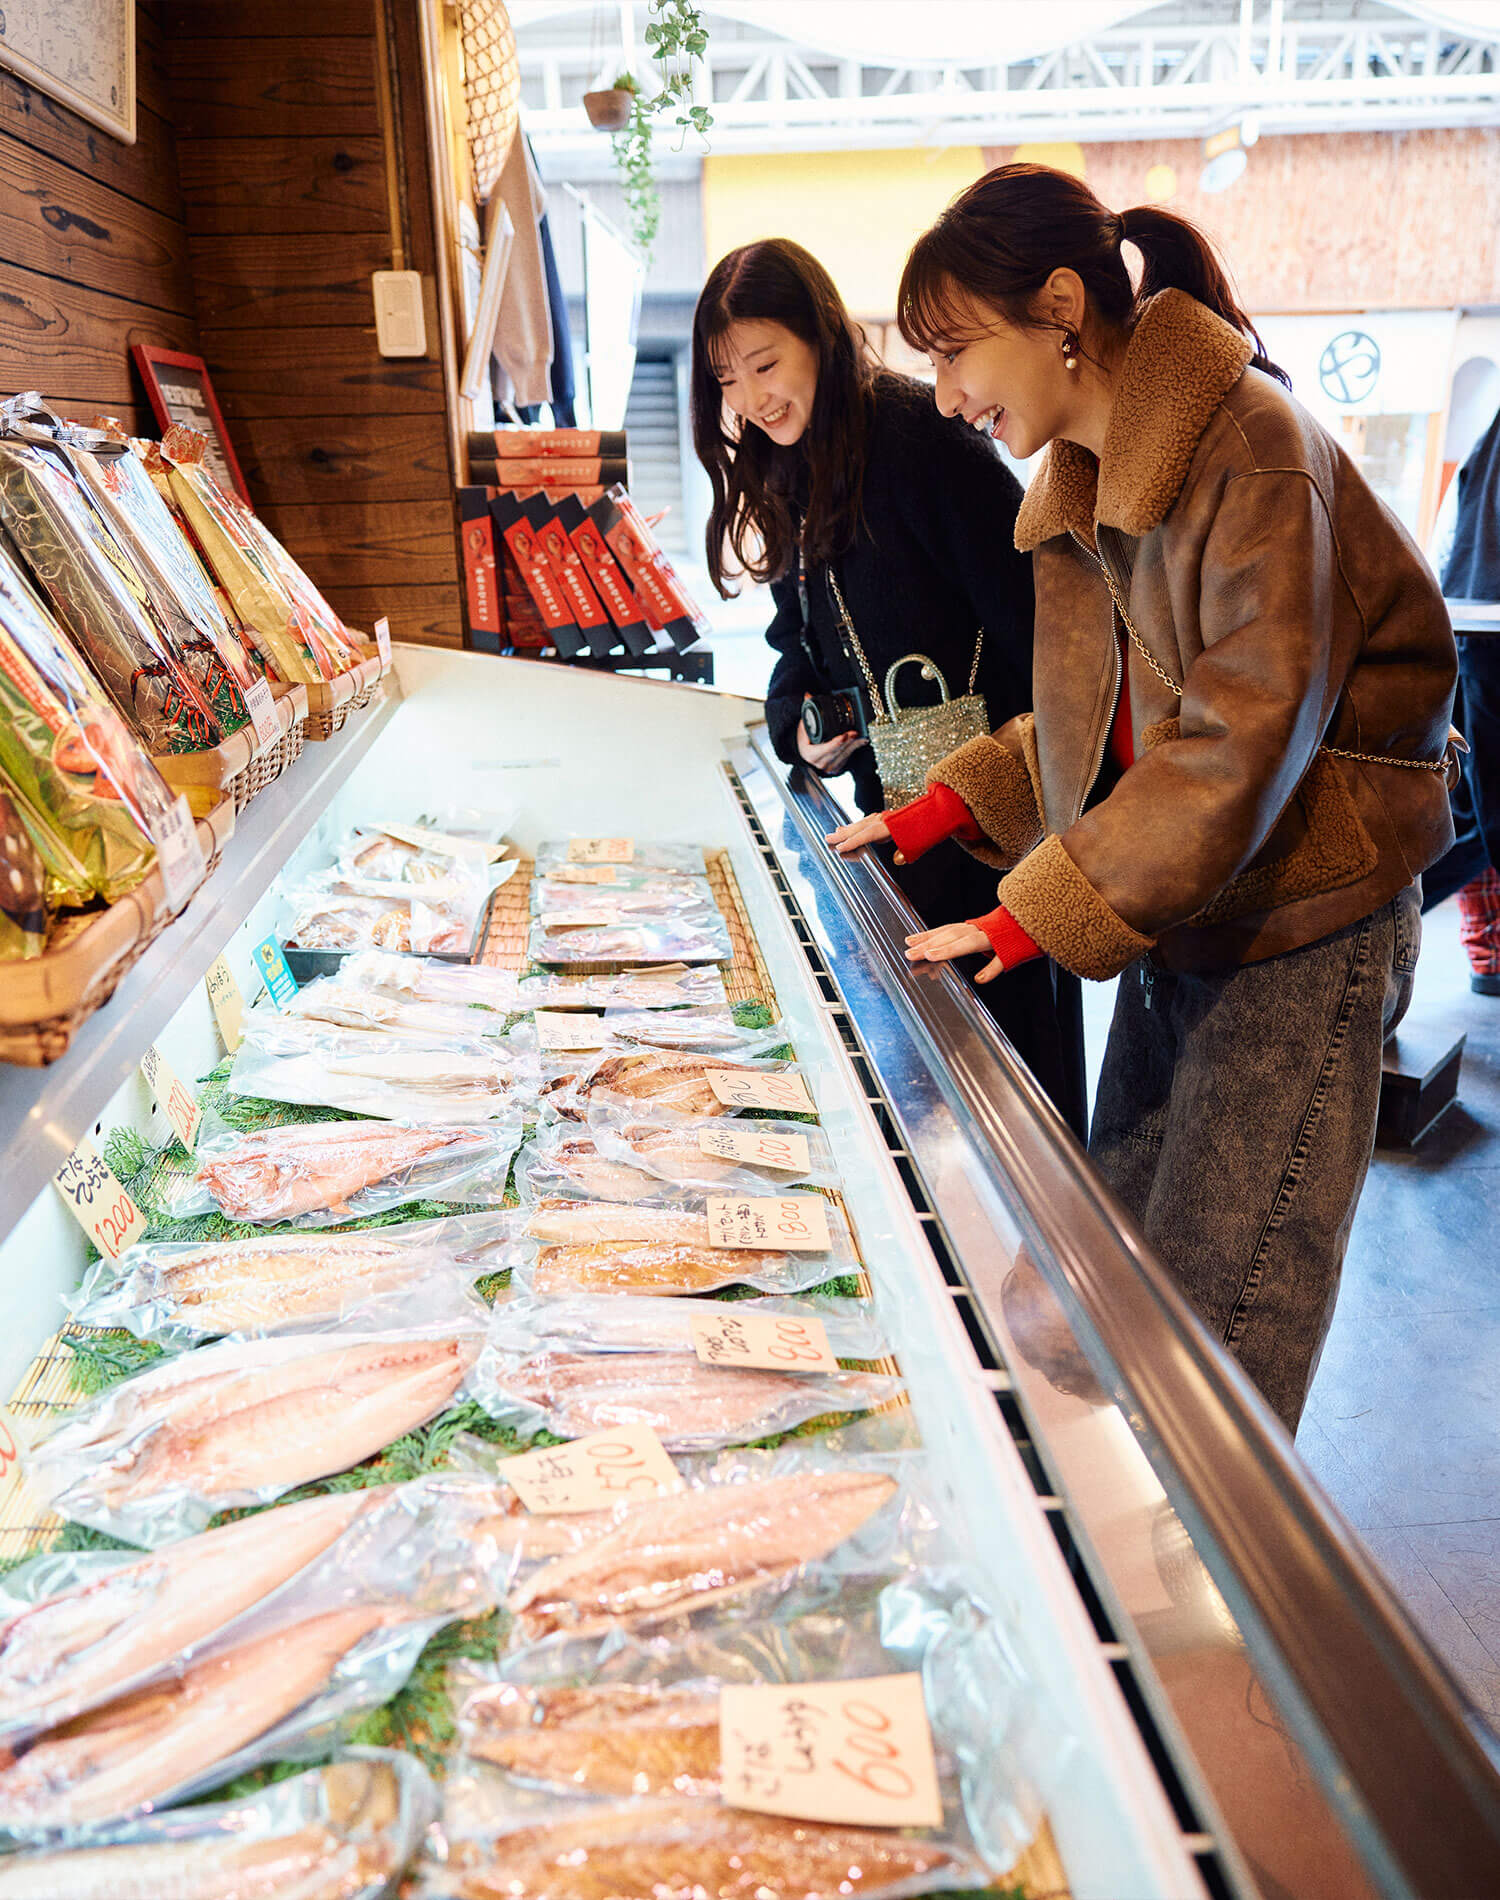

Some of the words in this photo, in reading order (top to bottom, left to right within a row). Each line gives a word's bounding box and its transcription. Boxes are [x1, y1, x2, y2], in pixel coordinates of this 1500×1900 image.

[719, 1073, 761, 1105] あじ
[761, 1075, 807, 1109] 600
[756, 1139, 797, 1167] 650
[76, 1155, 109, 1205] ひらき
[768, 1320, 823, 1361] 800
[586, 1443, 658, 1491] 570
[832, 1700, 916, 1800] 600
